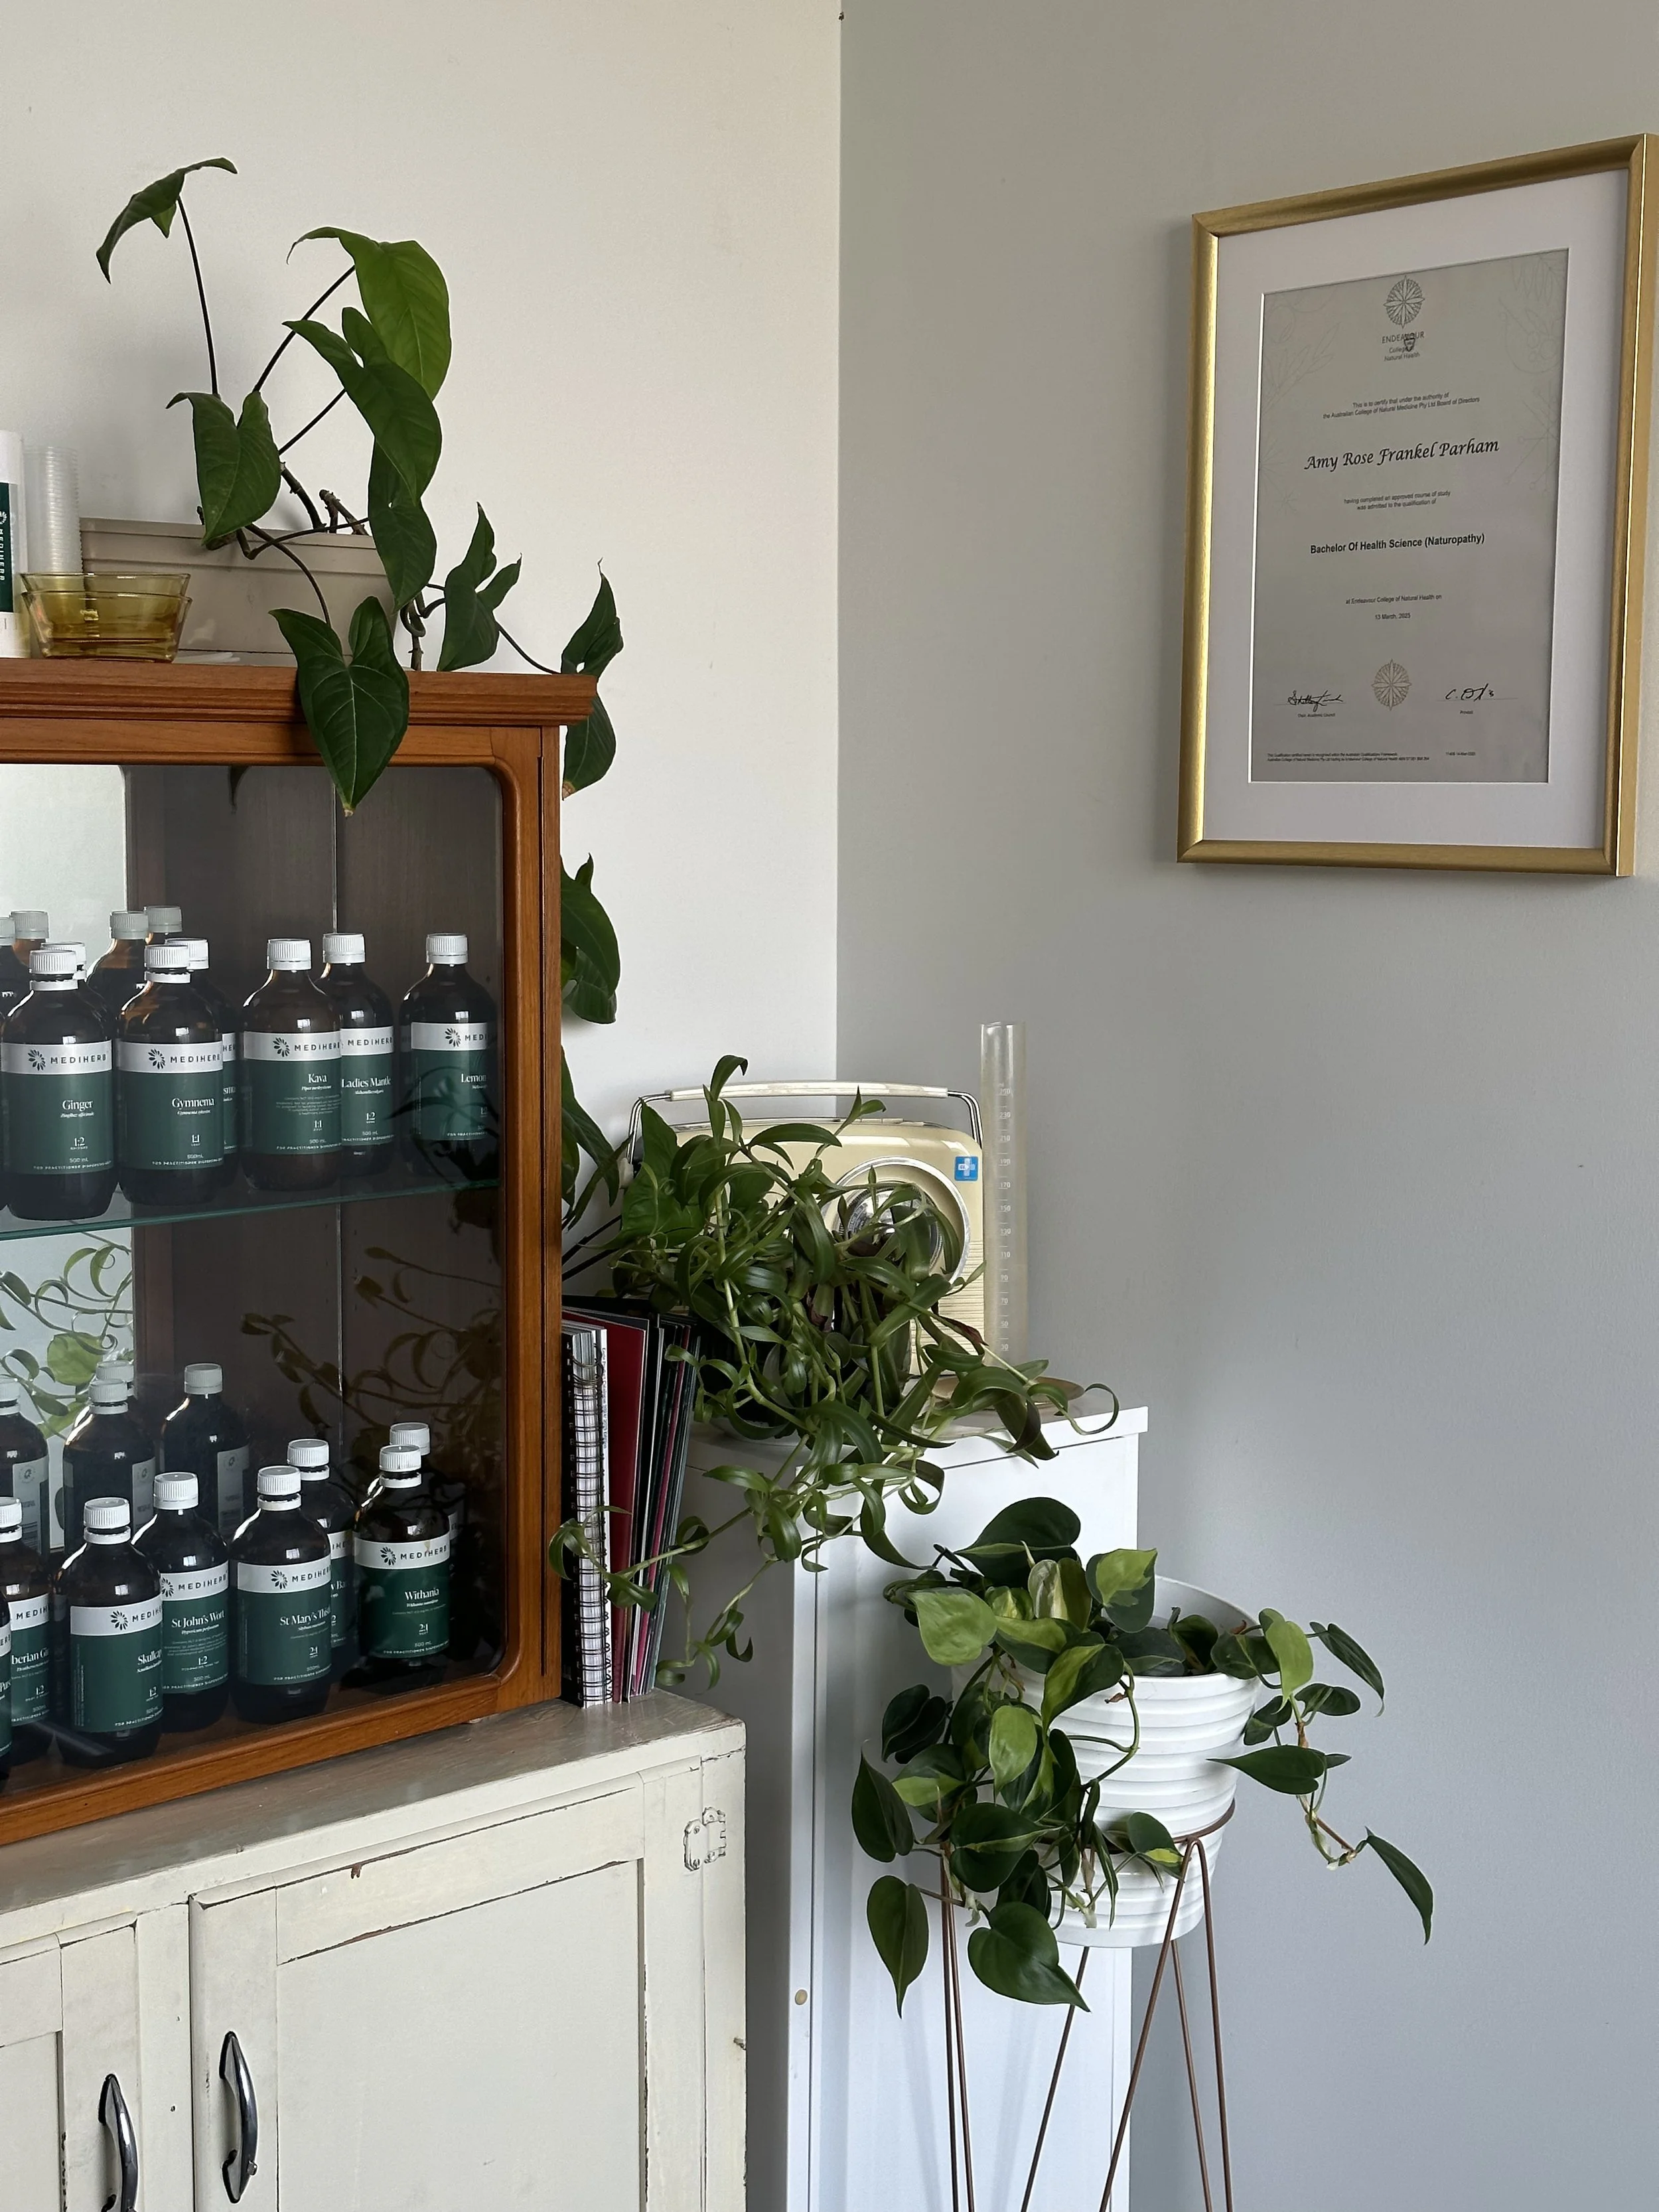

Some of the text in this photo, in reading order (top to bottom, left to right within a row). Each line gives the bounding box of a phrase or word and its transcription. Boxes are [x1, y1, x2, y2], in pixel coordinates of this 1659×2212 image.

[1331, 409, 1354, 418] Australian
[1304, 438, 1499, 472] Amy Rose Frankel Parham
[1310, 533, 1485, 554] Bachelor Of Health Science (Naturopathy)
[50, 1054, 106, 1065] MEDIHERB
[170, 1053, 220, 1063] MEDIHERB
[309, 1074, 327, 1083] Kava
[342, 1078, 368, 1088] Ladies
[370, 1076, 391, 1087] Mantle
[461, 1073, 486, 1083] Lemon
[62, 1100, 94, 1112] Ginger
[172, 1098, 214, 1110] Gymnema
[366, 1112, 376, 1120] 1:2
[74, 1137, 86, 1147] 1:2
[400, 1544, 447, 1560] MEDIHERB
[179, 1573, 226, 1590] MEDIHERB
[405, 1587, 439, 1600] Withania
[16, 1607, 48, 1620] MEDIH
[171, 1609, 225, 1628] St John's Wort
[280, 1617, 289, 1626] St
[291, 1611, 317, 1625] Mary's
[419, 1623, 429, 1633] 2:1
[11, 1652, 39, 1665] berian
[198, 1656, 208, 1665] 1:2
